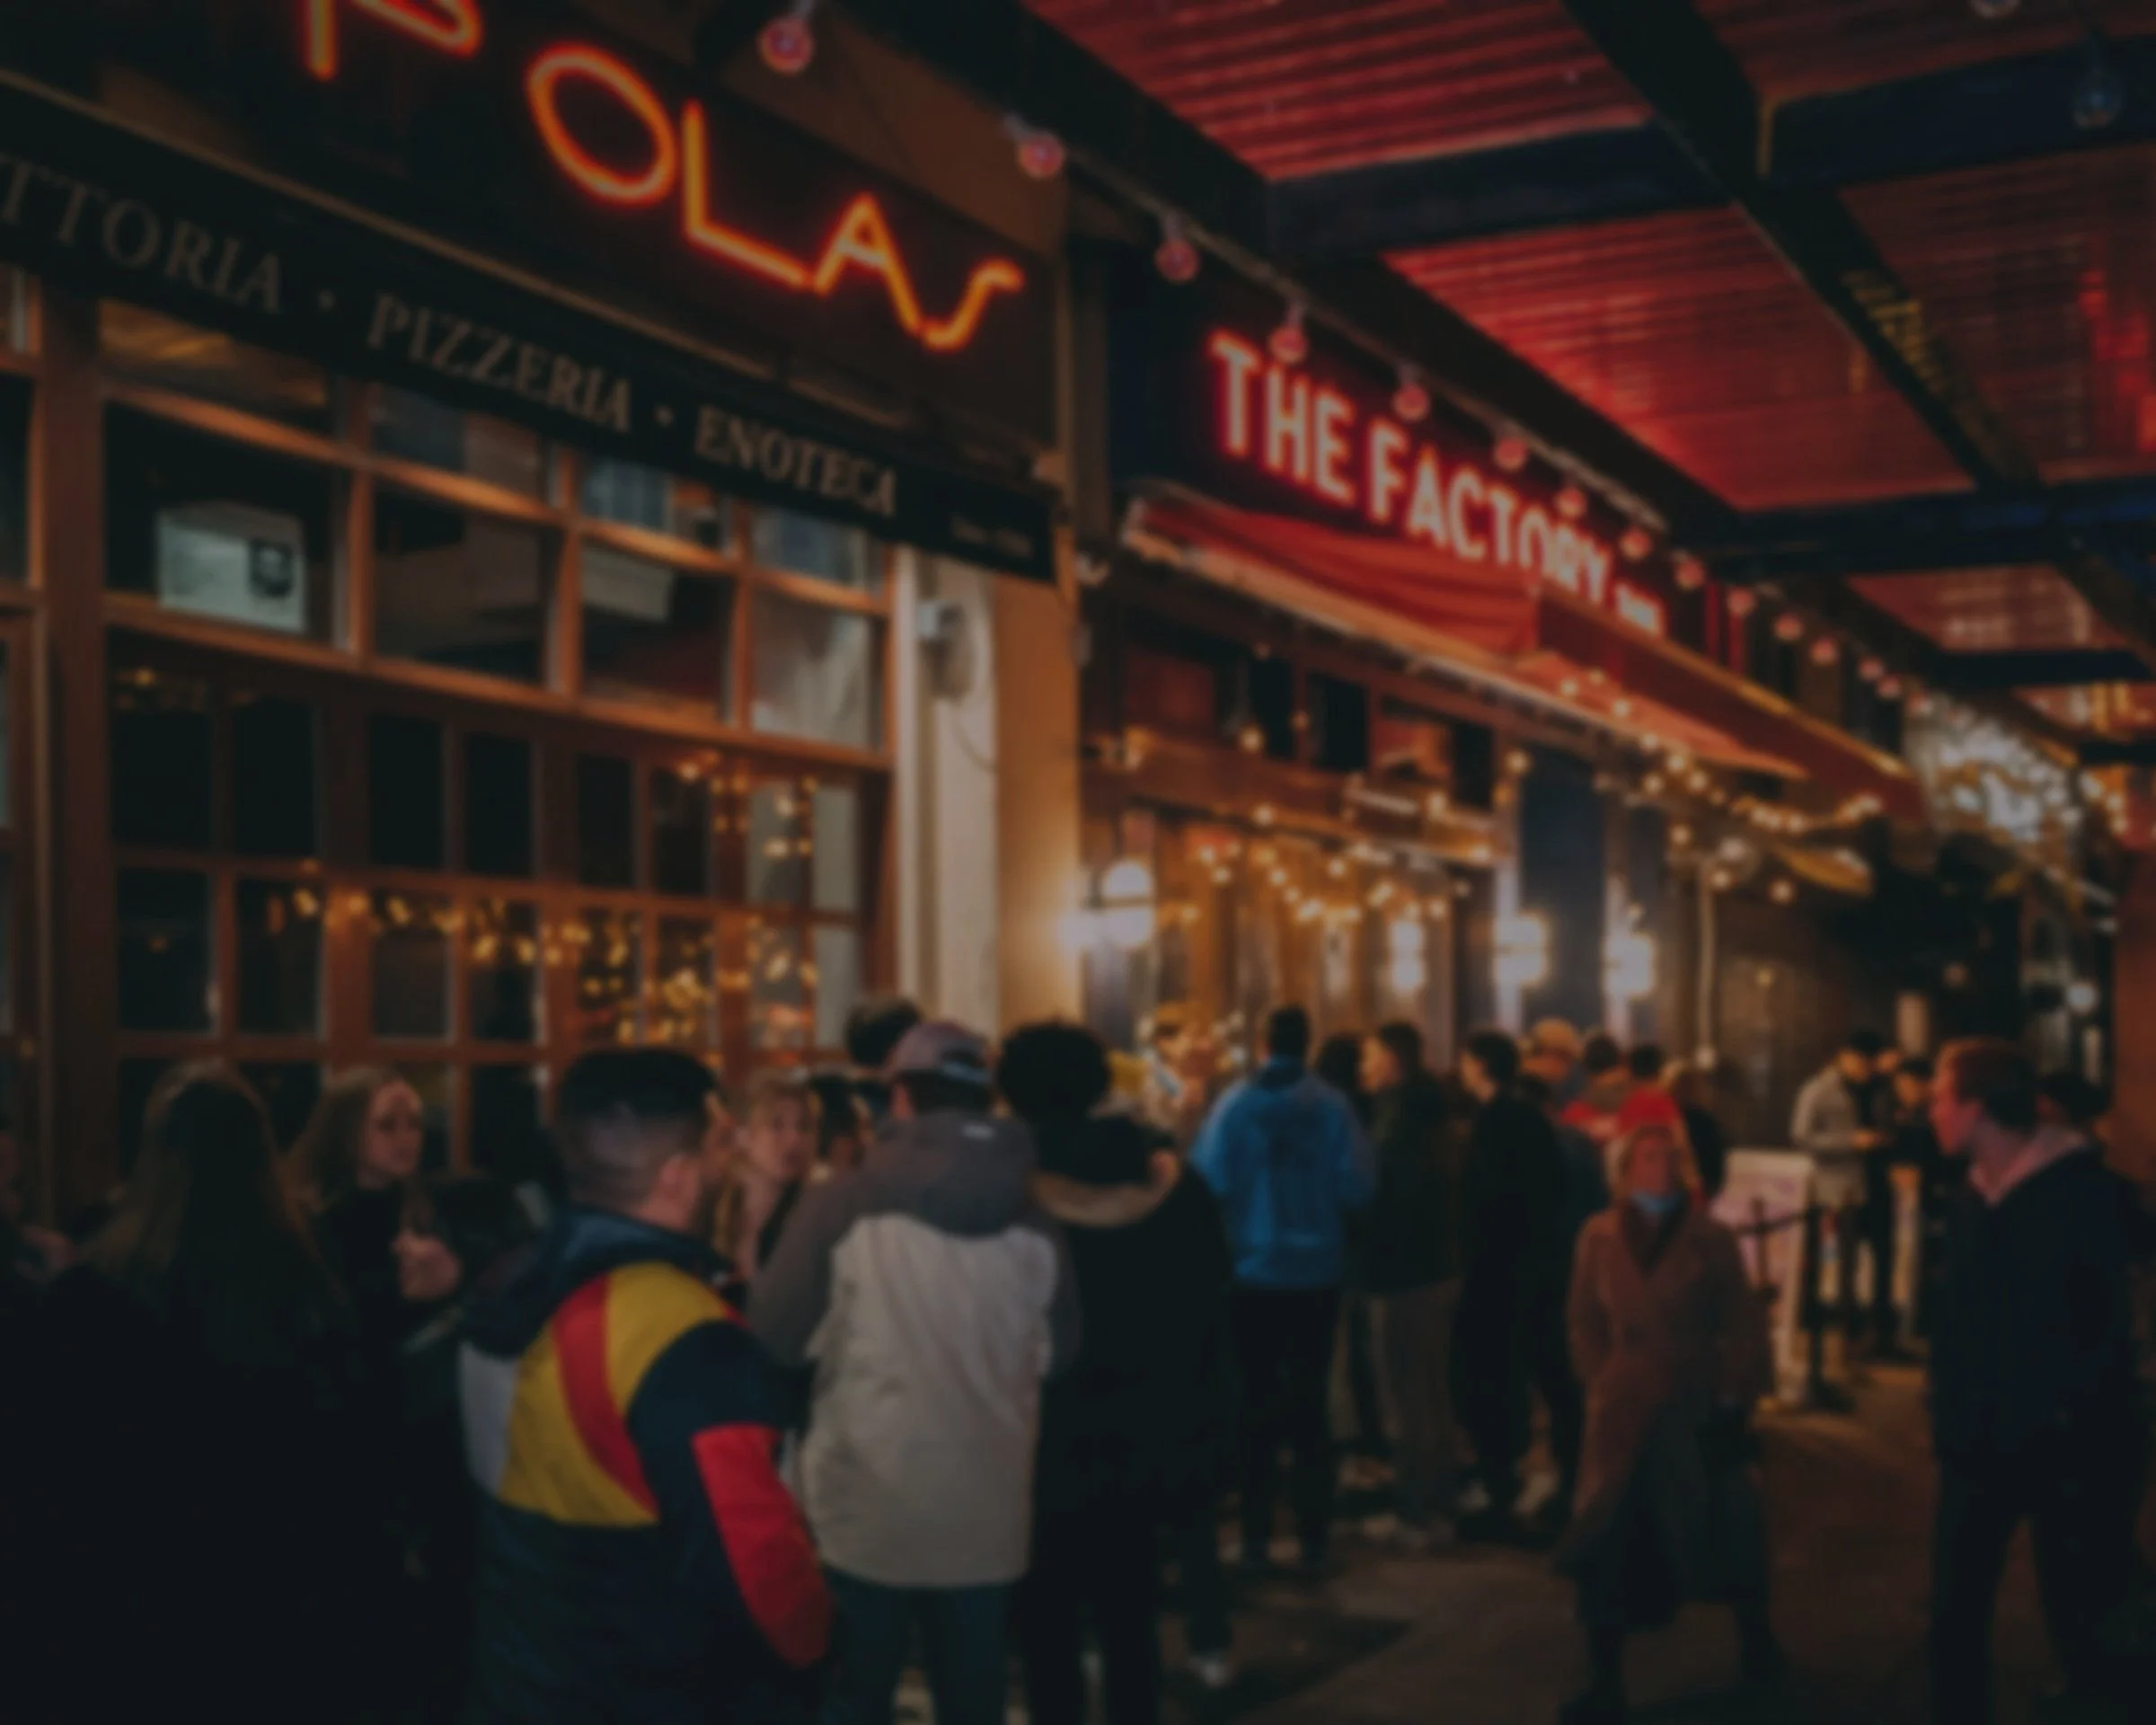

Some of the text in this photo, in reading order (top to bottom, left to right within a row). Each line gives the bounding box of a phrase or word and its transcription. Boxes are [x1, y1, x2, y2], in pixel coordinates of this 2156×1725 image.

[367, 291, 632, 434] PIZZERIA
[693, 403, 897, 518] ENOTECA
[1209, 326, 1613, 606] THE FACTORY
